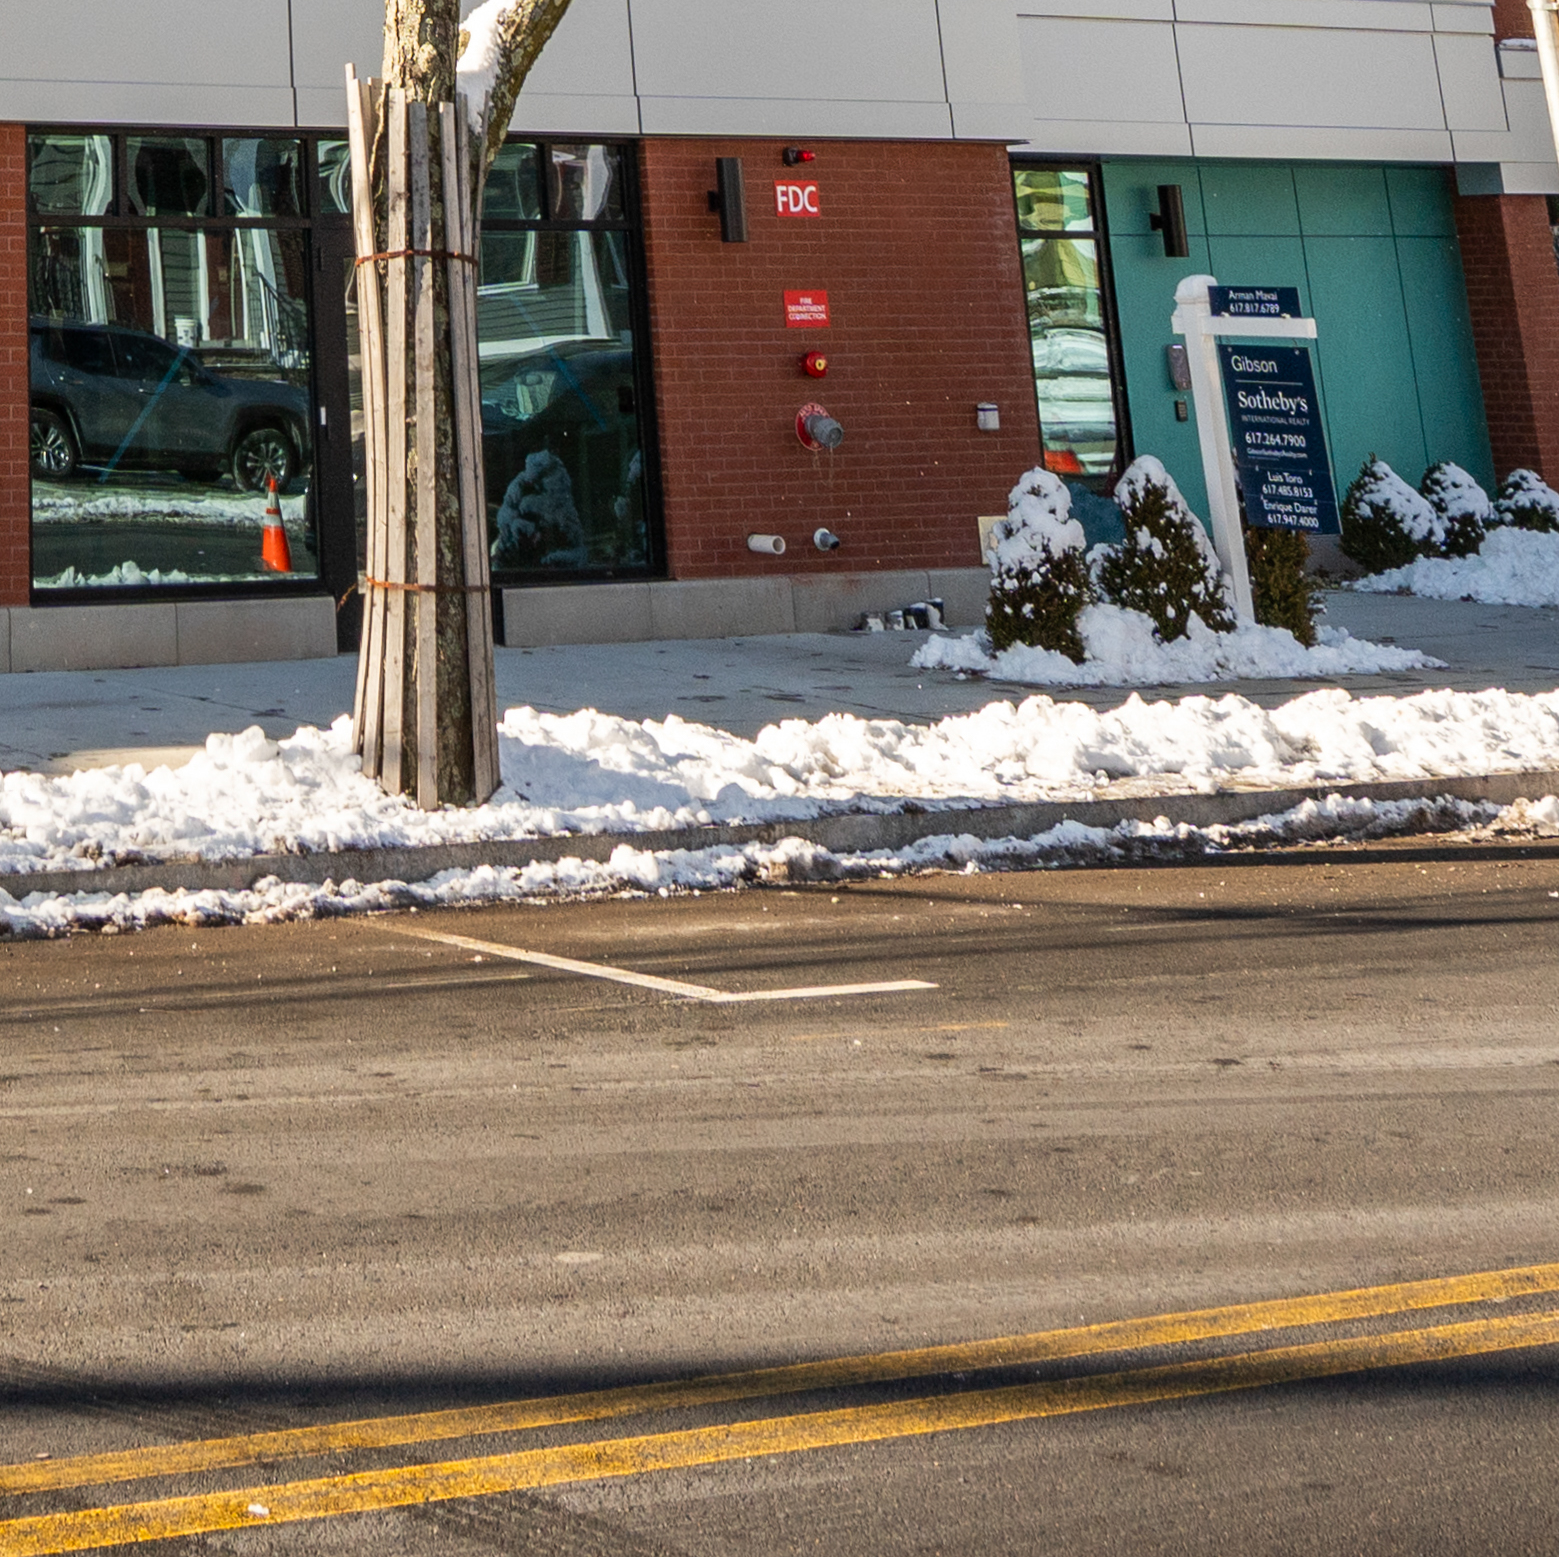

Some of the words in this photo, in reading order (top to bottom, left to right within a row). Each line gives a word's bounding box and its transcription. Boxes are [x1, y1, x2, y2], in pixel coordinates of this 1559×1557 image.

[776, 185, 818, 213] FDC
[788, 313, 827, 321] CONNECTION
[1231, 355, 1278, 373] Gibson
[1237, 389, 1308, 415] Sotheby's
[1241, 415, 1288, 425] INTERNATIONAL
[1289, 418, 1310, 426] REALTY
[1245, 432, 1306, 448] 617.264.7900
[1267, 471, 1284, 482] Luis
[1283, 472, 1303, 484] Toro
